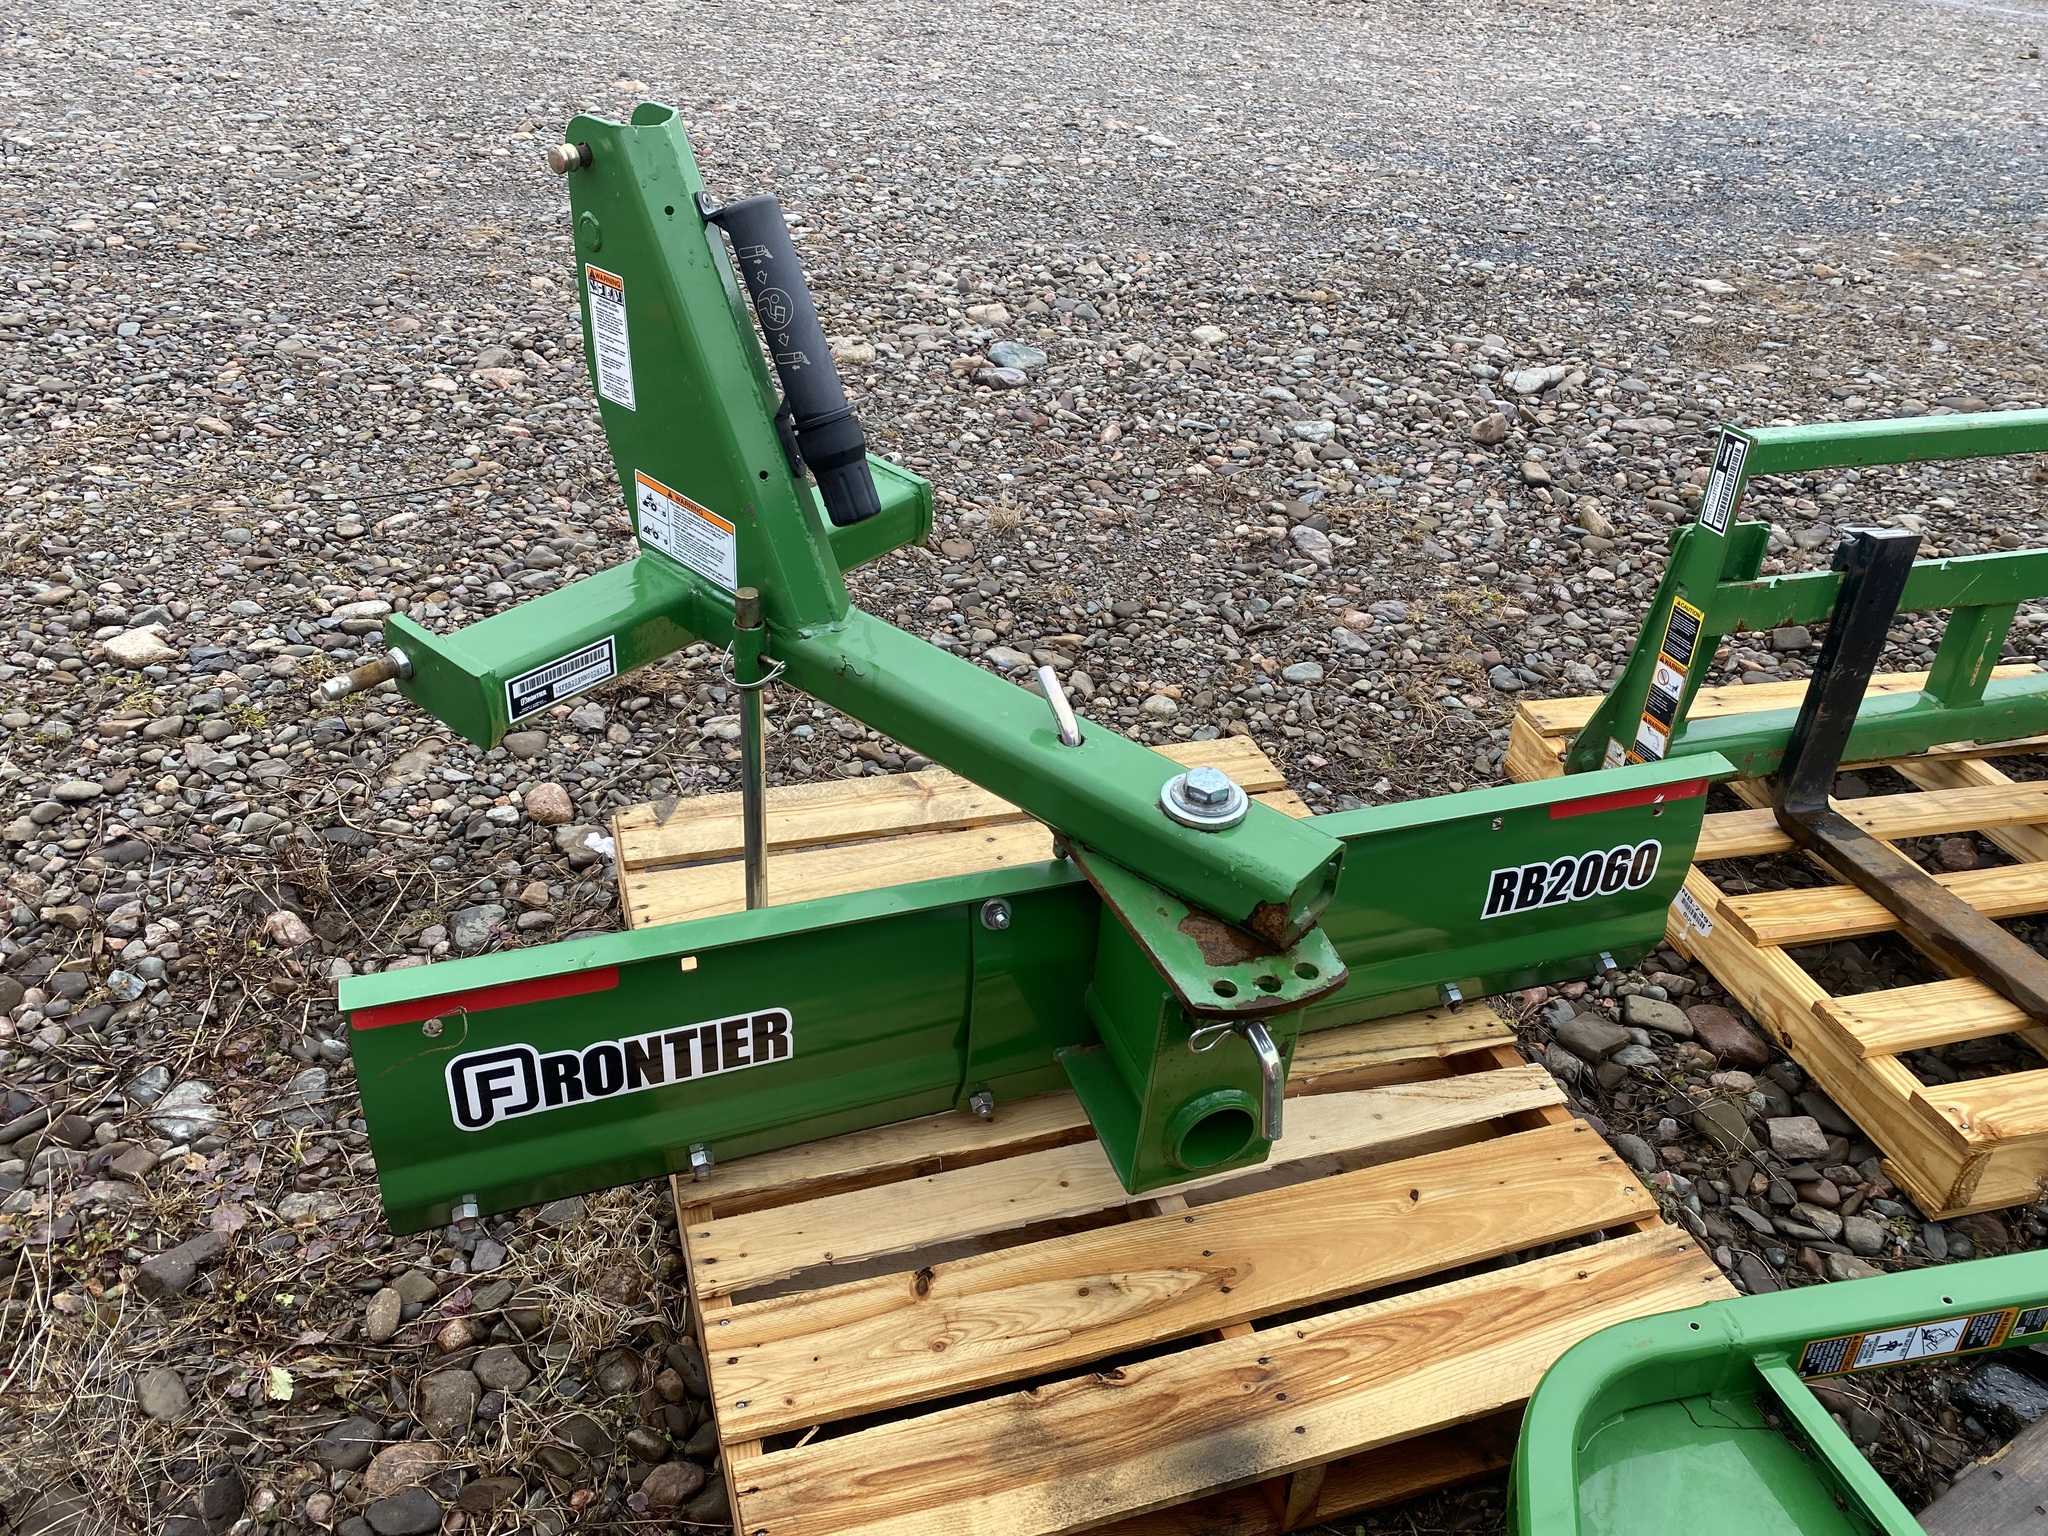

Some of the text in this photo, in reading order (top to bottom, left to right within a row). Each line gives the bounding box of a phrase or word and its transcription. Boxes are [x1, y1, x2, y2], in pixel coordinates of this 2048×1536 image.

[595, 271, 621, 288] WARNING
[675, 495, 704, 516] WARNING
[1680, 602, 1701, 618] CAUTION
[1665, 660, 1687, 676] WARNING
[1648, 719, 1669, 738] WARNING
[1485, 843, 1659, 916] RB2060
[1682, 888, 1713, 927] NB-7397
[449, 1011, 789, 1129] FRONTIER
